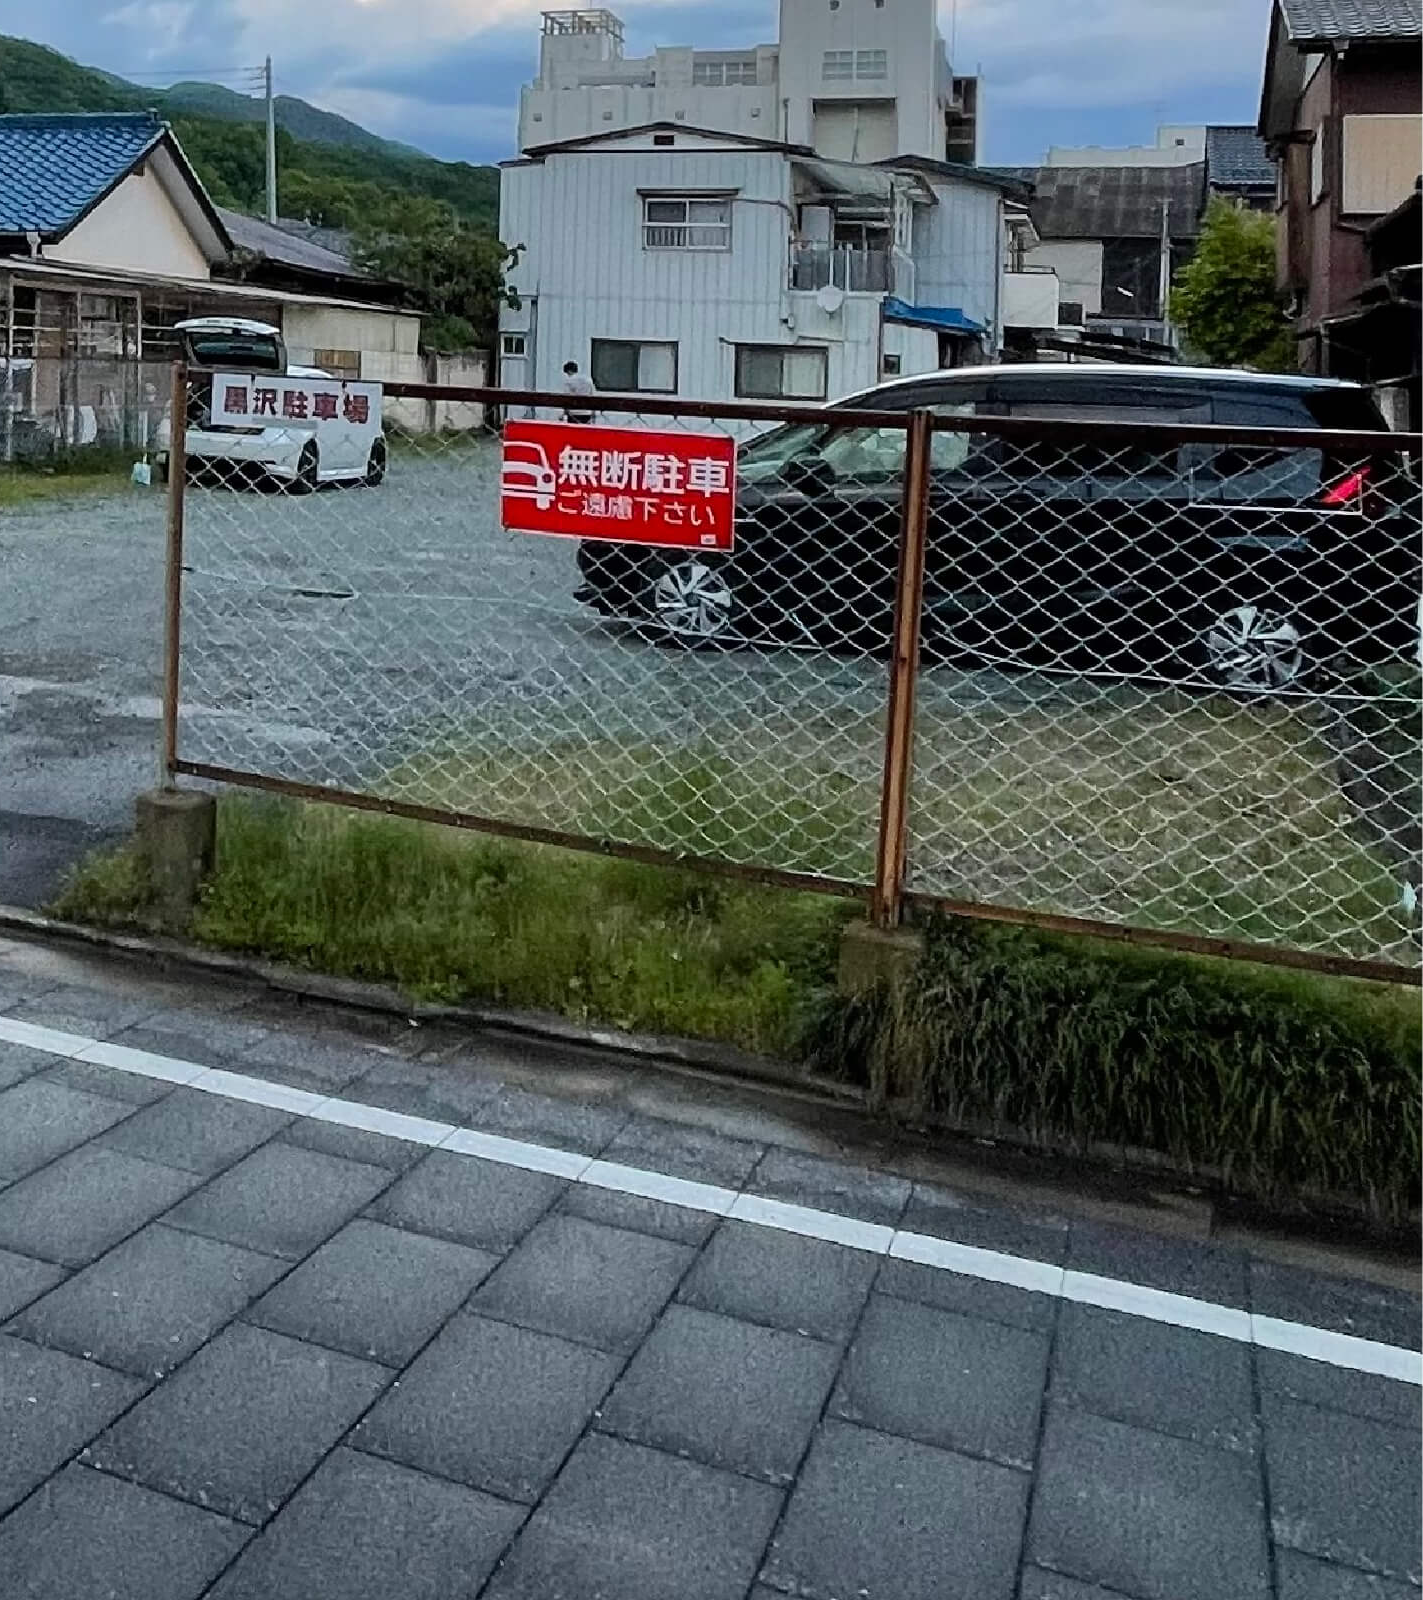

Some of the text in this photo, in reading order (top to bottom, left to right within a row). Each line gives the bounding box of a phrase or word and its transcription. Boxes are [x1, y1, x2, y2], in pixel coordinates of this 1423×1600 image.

[557, 444, 730, 498] 無断駐車
[557, 489, 716, 526] ご遠慮下さい
